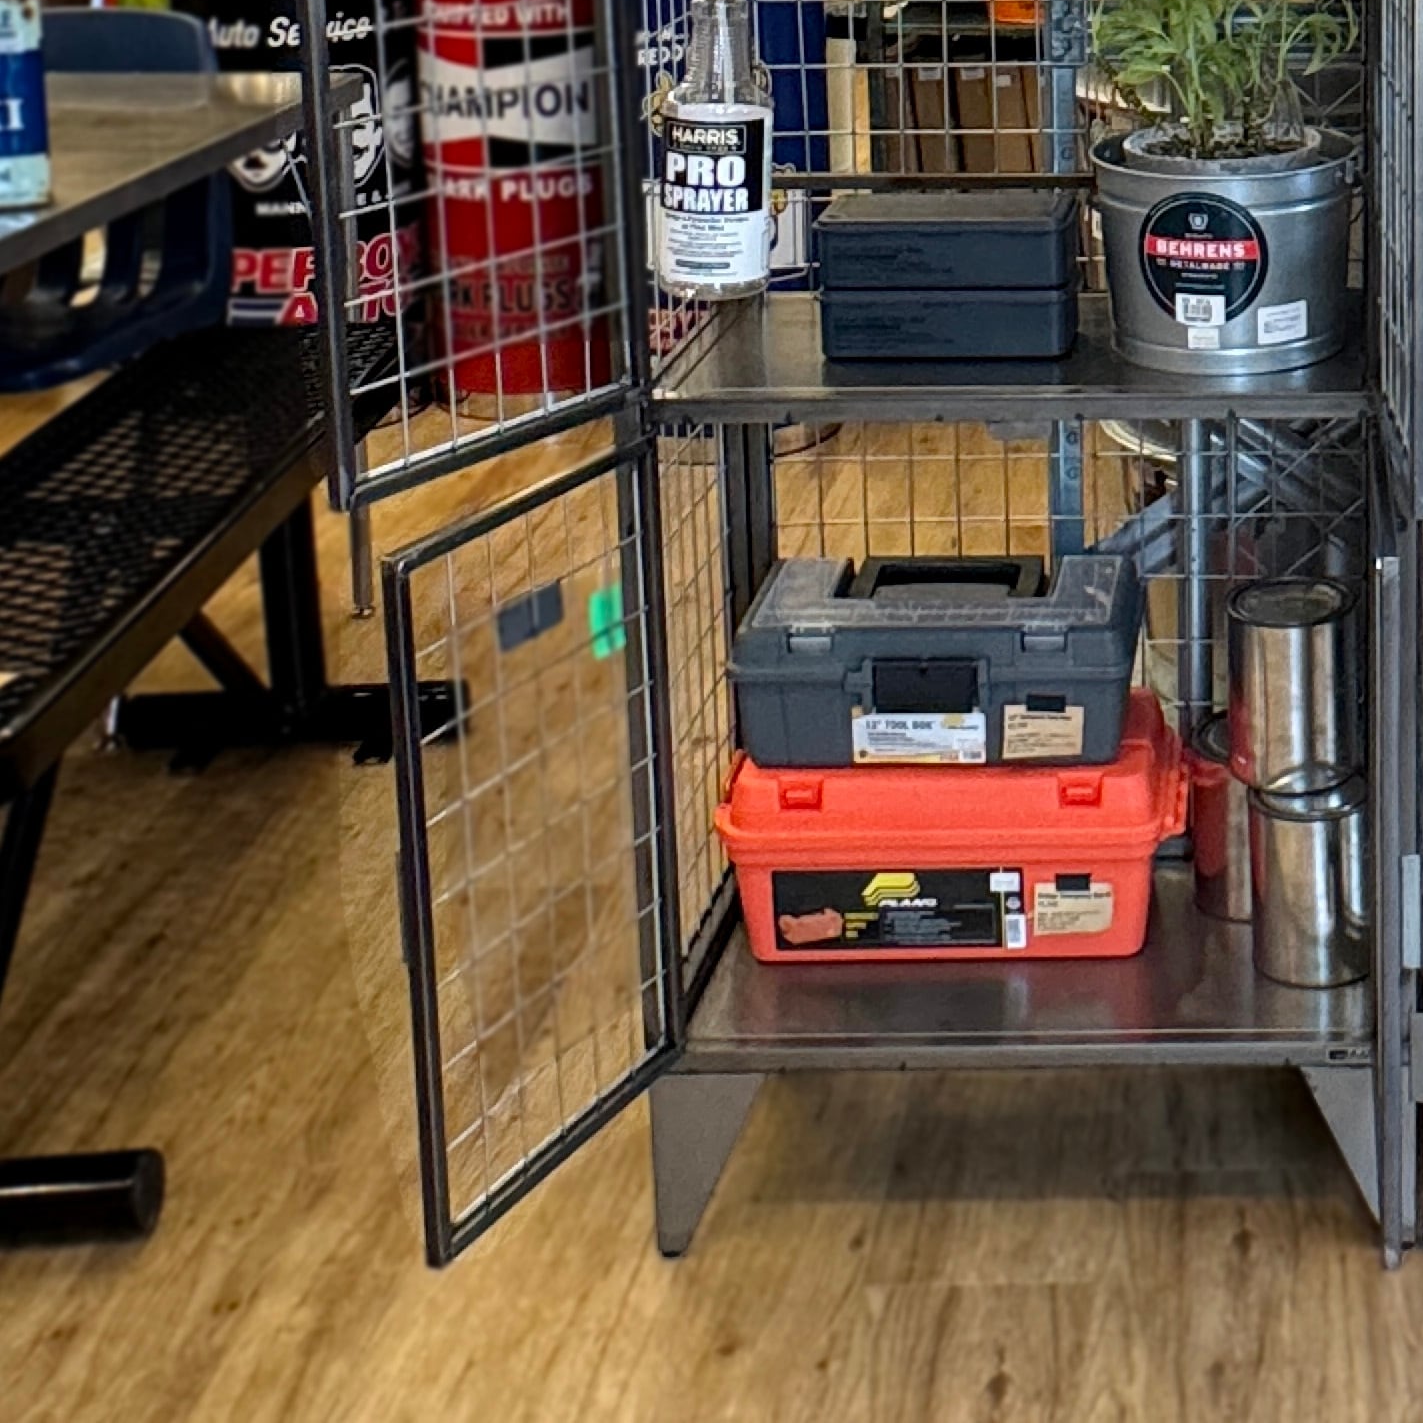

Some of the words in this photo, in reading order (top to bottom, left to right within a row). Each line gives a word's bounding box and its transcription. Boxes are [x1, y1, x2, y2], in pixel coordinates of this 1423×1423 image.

[666, 152, 746, 186] PRO
[662, 187, 749, 212] SPRAYER
[1156, 240, 1245, 259] BEHRENS
